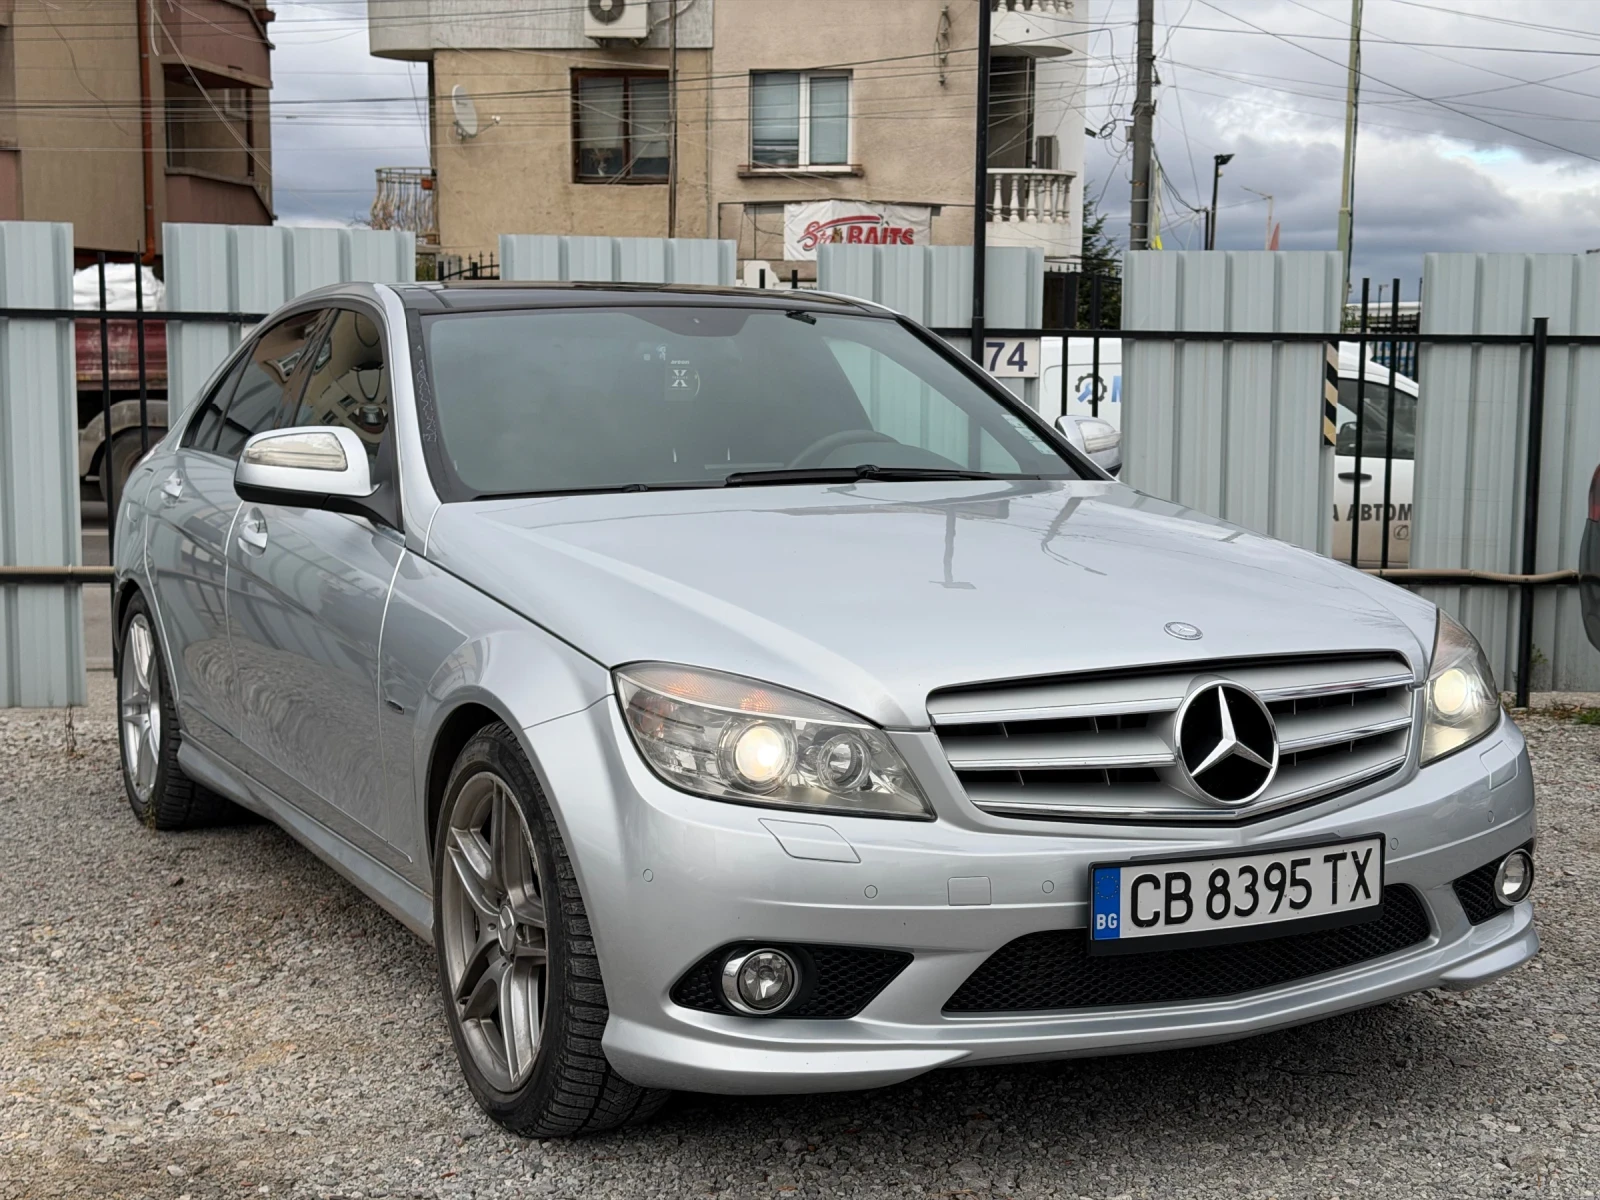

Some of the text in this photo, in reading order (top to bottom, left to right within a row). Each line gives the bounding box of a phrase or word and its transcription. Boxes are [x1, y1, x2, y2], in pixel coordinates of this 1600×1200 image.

[847, 225, 915, 245] BAITS
[985, 341, 1028, 372] 74
[1130, 847, 1373, 929] CB 8395 TX
[1096, 912, 1118, 930] BG
